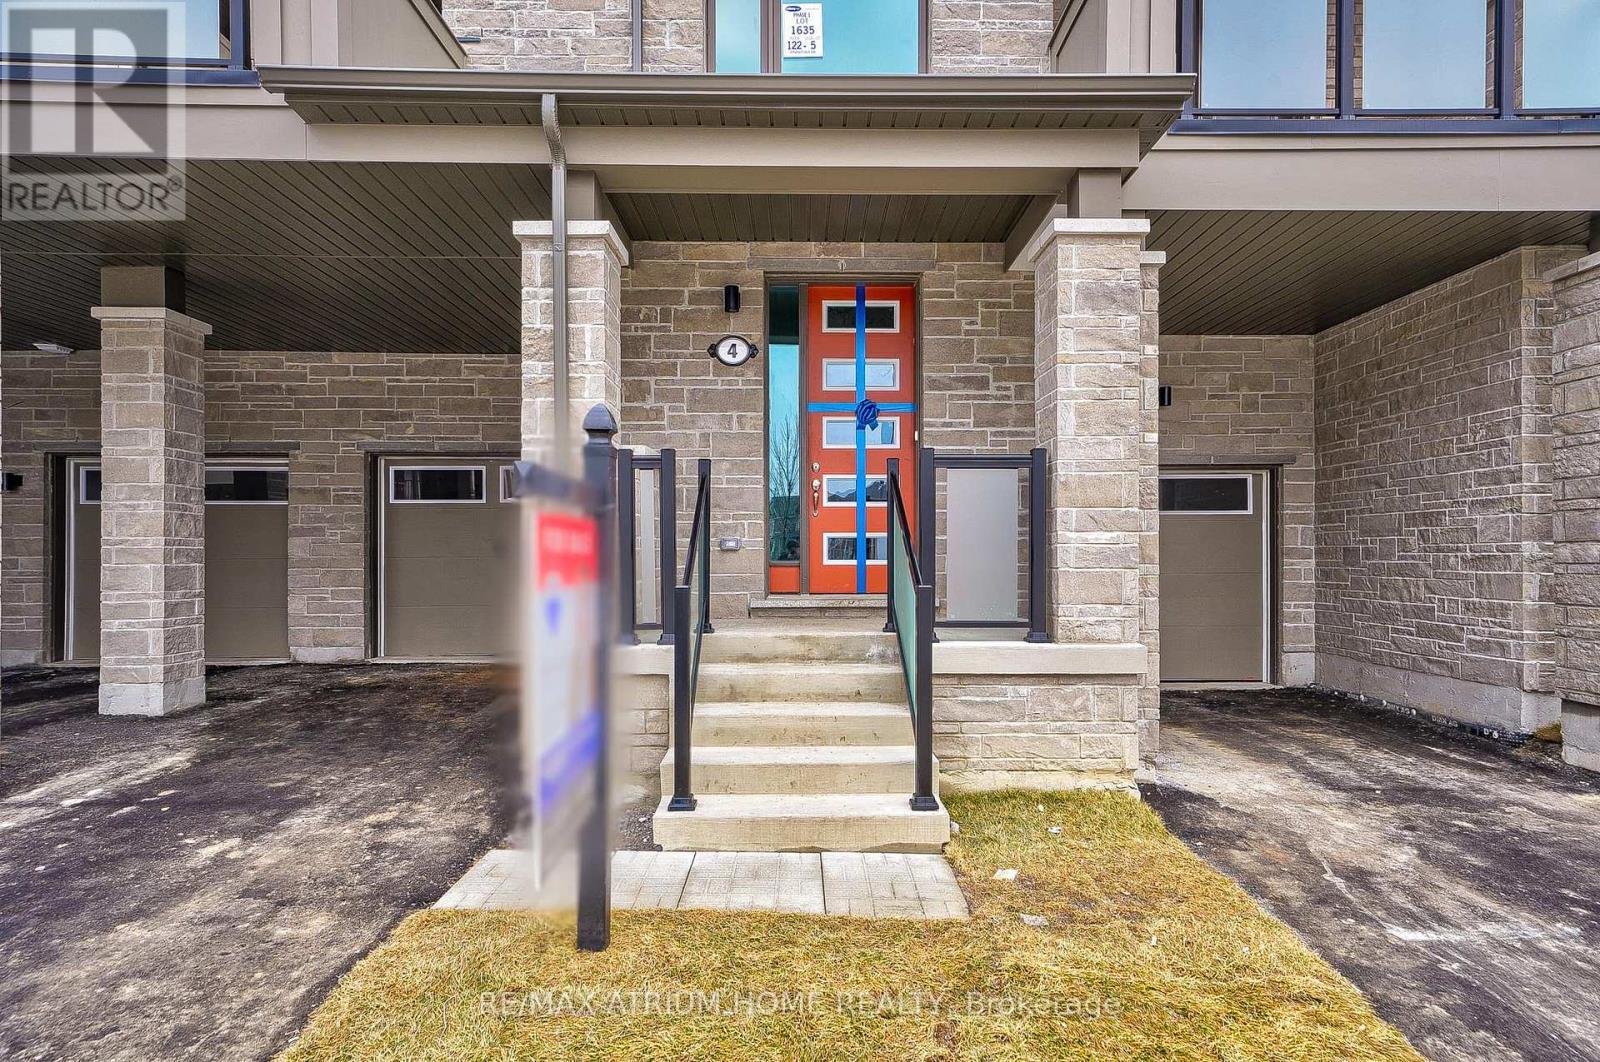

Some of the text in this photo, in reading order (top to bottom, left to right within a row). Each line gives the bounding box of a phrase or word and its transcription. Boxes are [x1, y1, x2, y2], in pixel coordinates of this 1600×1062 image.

[791, 25, 815, 35] 1635
[810, 40, 817, 50] 5
[727, 343, 738, 358] 4
